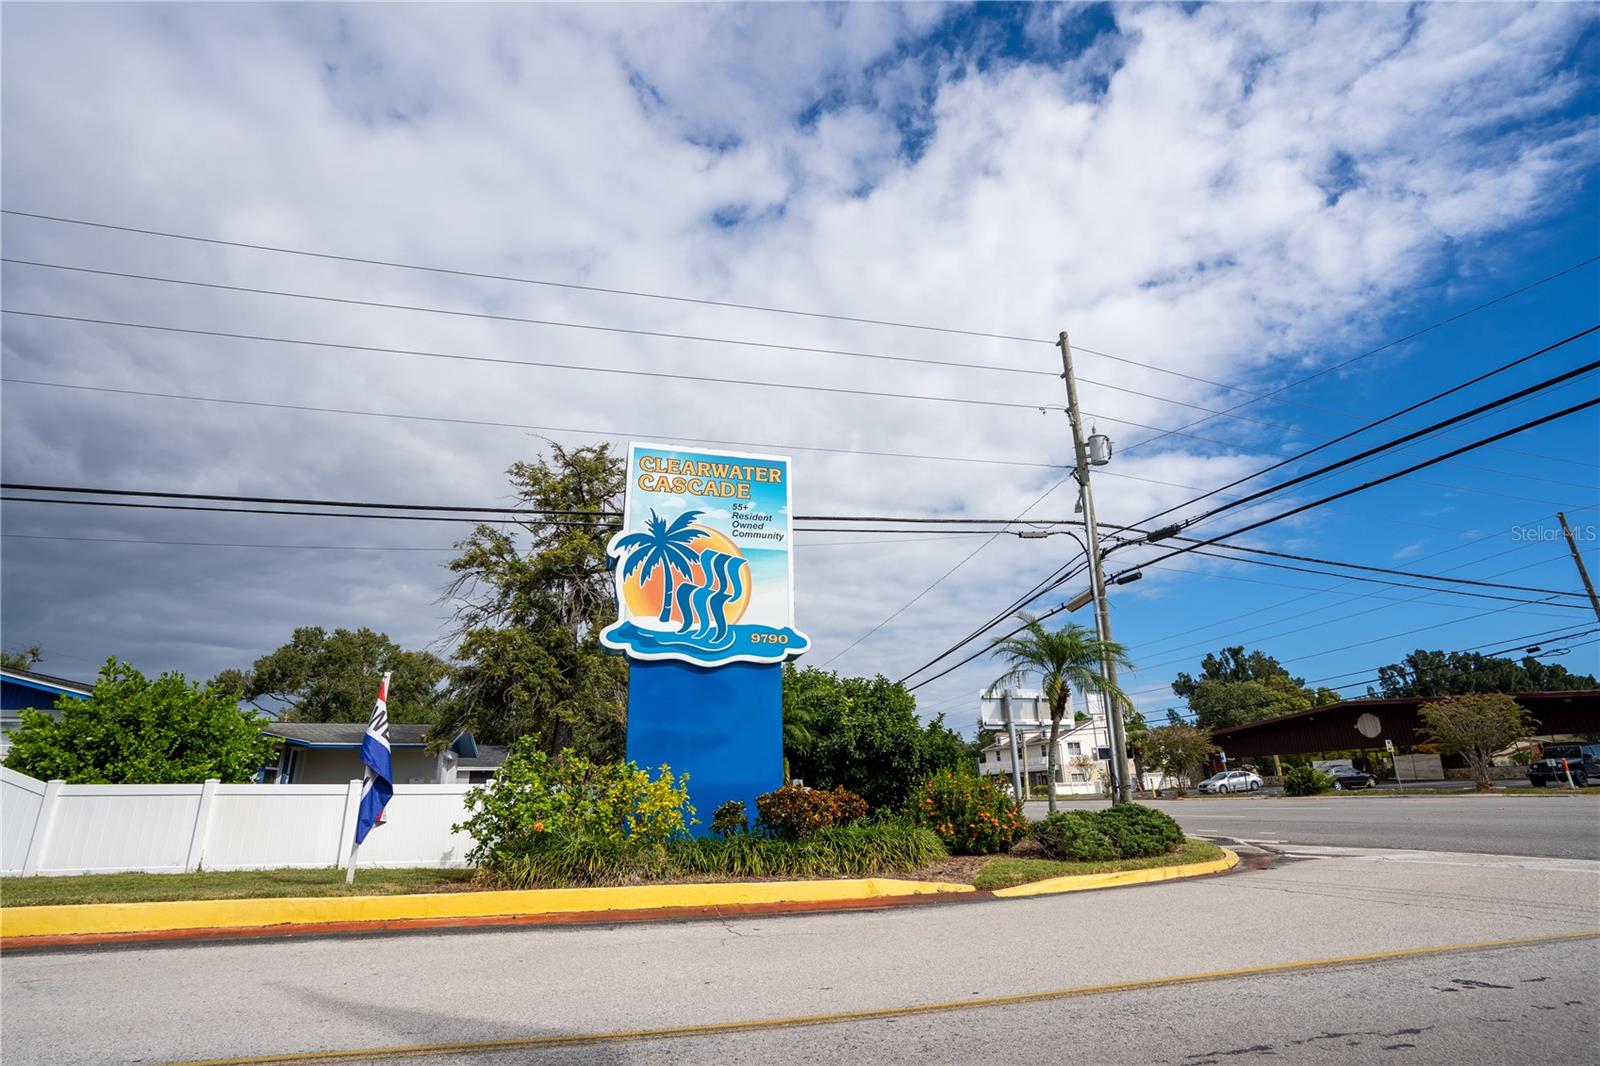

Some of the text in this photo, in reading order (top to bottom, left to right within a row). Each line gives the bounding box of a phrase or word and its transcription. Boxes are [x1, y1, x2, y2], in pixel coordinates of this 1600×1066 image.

[640, 456, 781, 482] CLEARWATER
[638, 474, 751, 499] CASCADE
[732, 503, 748, 511] 55+
[732, 512, 772, 521] Resident
[732, 521, 764, 530] Owned
[732, 530, 784, 541] Community
[751, 633, 789, 644] 9790
